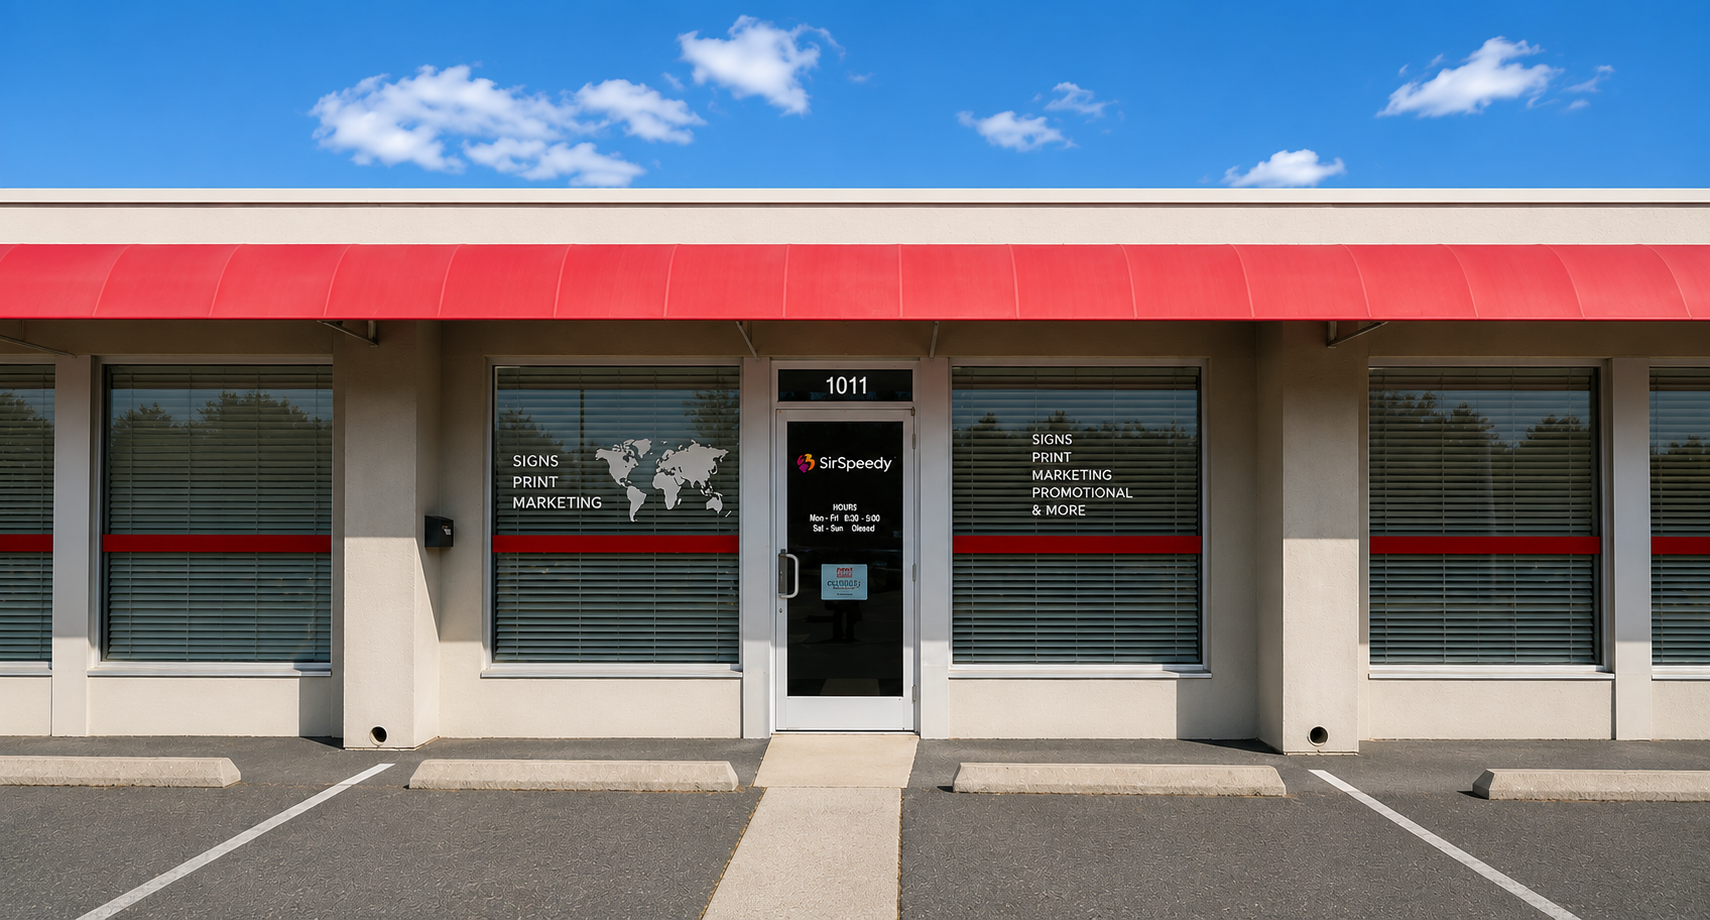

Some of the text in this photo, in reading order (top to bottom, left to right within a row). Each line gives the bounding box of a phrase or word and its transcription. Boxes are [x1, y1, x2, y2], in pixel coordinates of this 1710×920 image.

[826, 376, 867, 395] 1011
[1032, 433, 1073, 445] SIGNS
[513, 454, 559, 467] SIGNS
[1032, 452, 1072, 463] PRINT
[819, 456, 892, 473] SirSpeedy
[1032, 469, 1112, 481] MARKETING
[513, 475, 559, 488] PRINT
[1032, 487, 1133, 498] PROMOTIONAL
[513, 496, 602, 509] MARKETING
[832, 503, 858, 511] HOURS
[1031, 504, 1086, 516] & MORE
[809, 513, 825, 522] Mon
[830, 524, 844, 532] Sun
